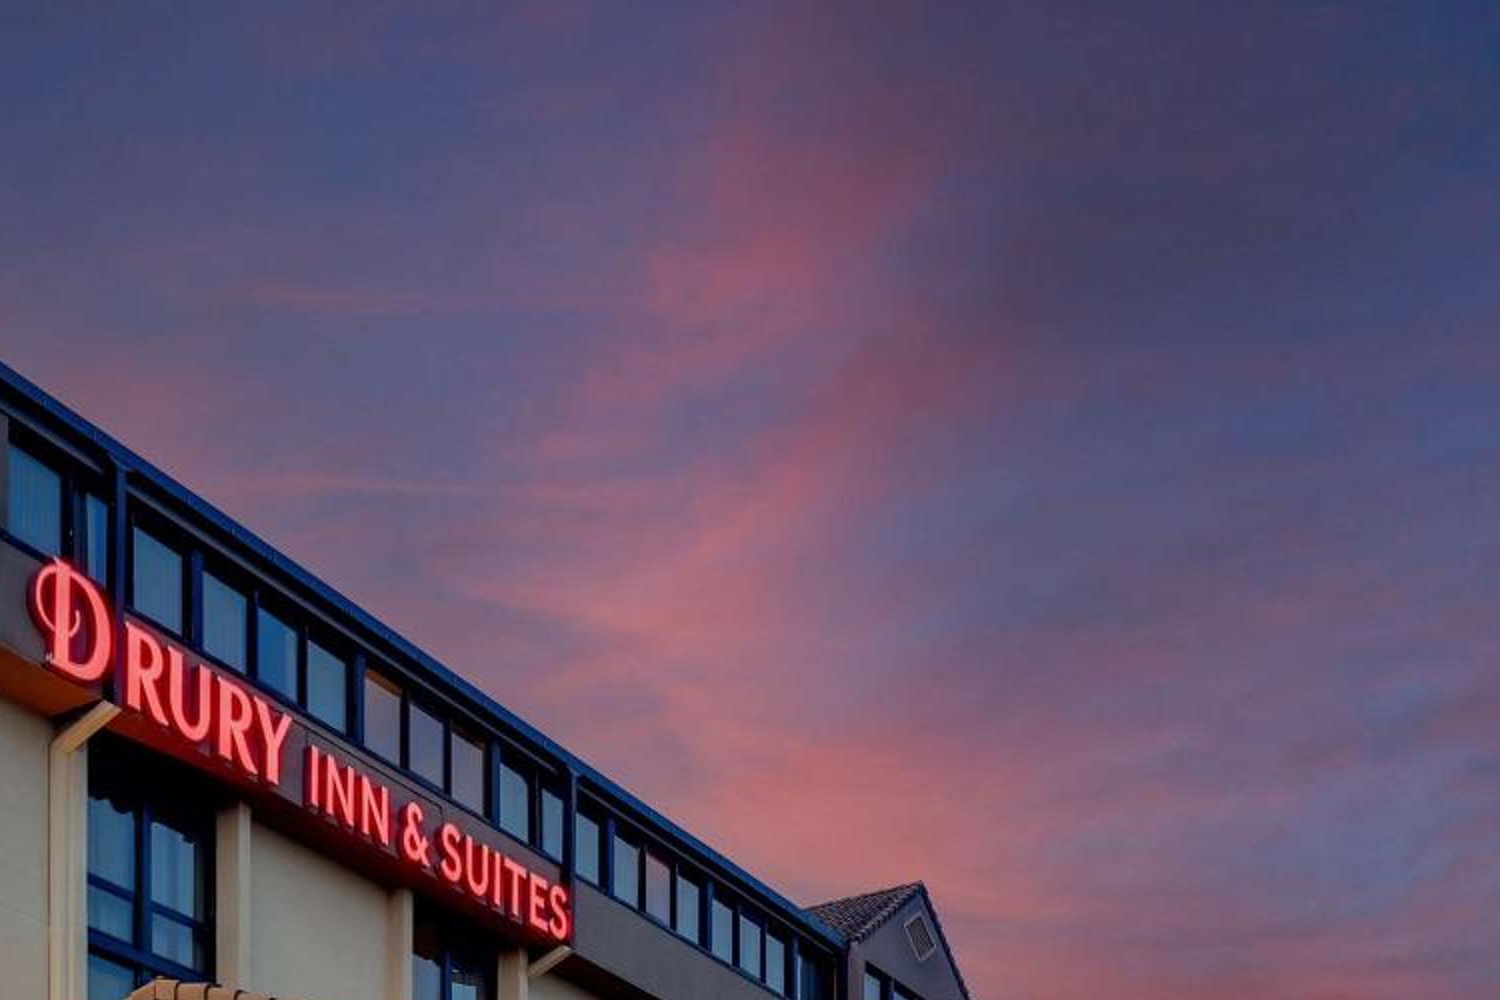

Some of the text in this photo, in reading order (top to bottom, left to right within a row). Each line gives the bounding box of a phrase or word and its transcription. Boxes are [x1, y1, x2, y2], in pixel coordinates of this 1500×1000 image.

[32, 556, 570, 942] DRURY INN & SUITES
